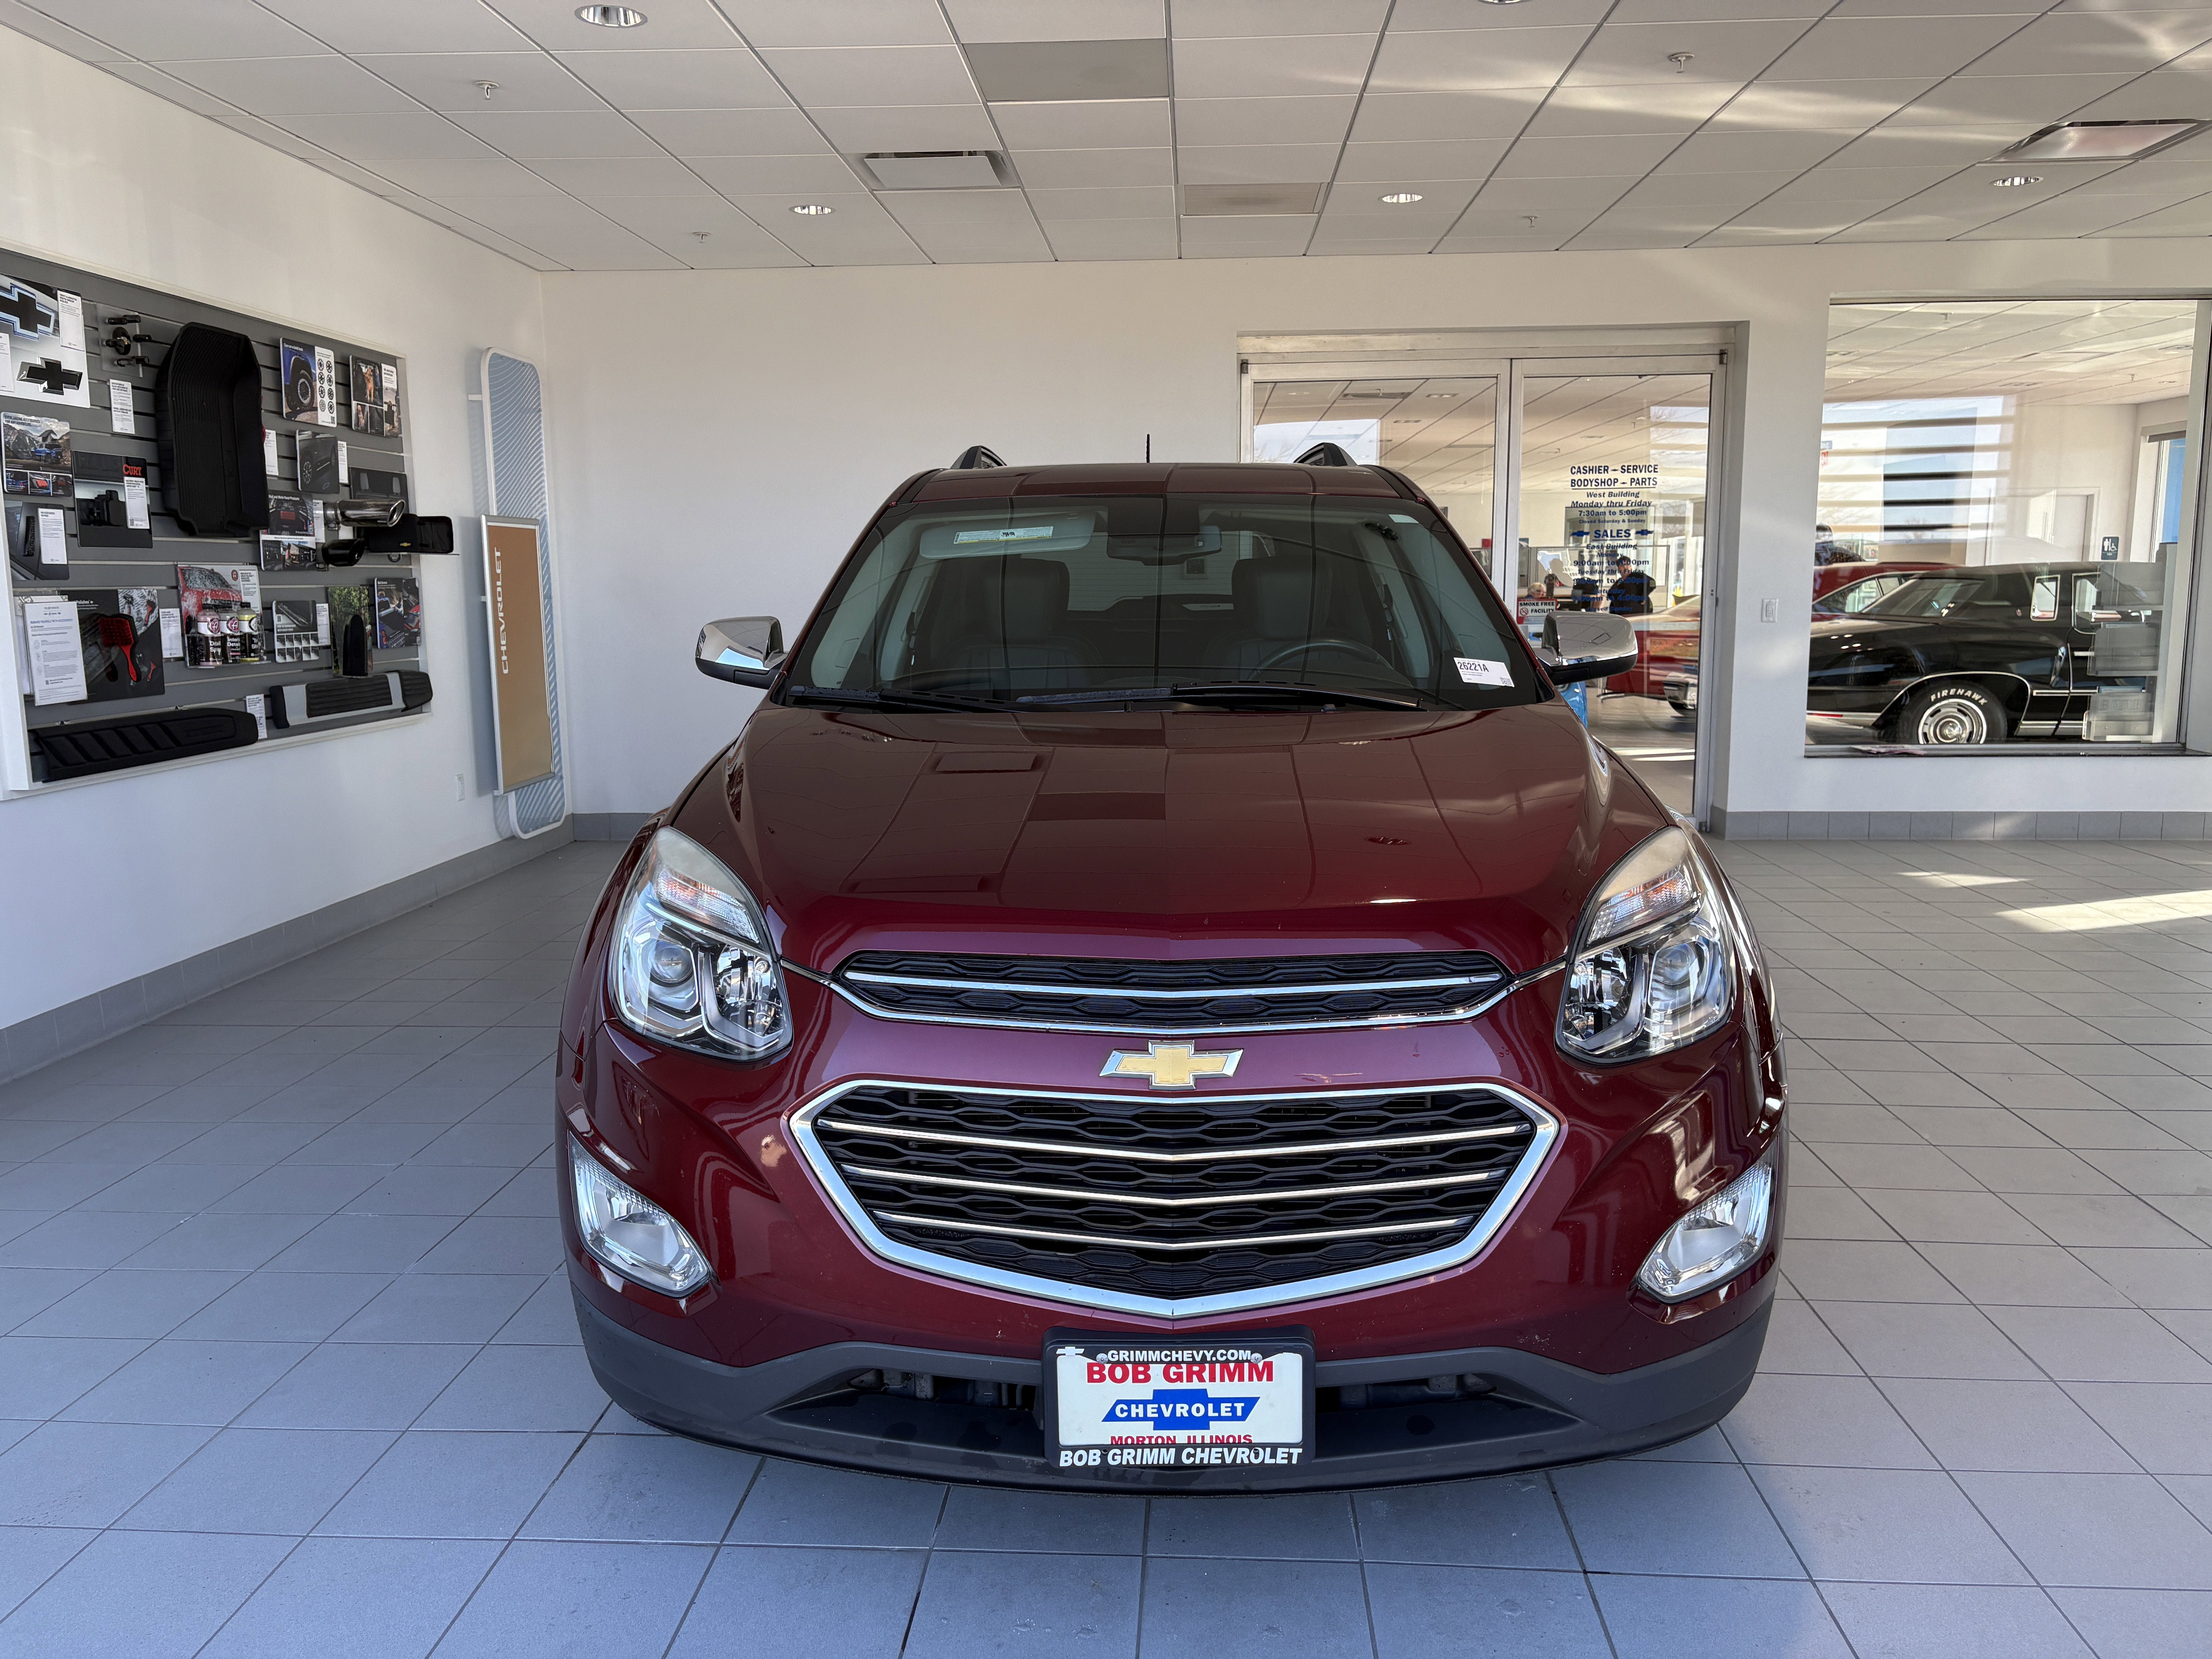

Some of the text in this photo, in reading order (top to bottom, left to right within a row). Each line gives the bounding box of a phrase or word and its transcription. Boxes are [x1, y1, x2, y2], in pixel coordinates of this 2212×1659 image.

[123, 464, 142, 476] CURT
[1570, 465, 1609, 475] CASHIER
[1620, 464, 1659, 474] SERVICE
[1570, 478, 1619, 487] BODYSHOP
[1630, 477, 1657, 486] PARTS
[1594, 529, 1631, 538] SALES
[494, 547, 508, 674] CHEVROLET
[1458, 661, 1489, 672] 26221A
[1930, 688, 1988, 706] FIREHAWK
[1108, 1350, 1251, 1362] GRIMMCHEVY.COM
[1087, 1361, 1273, 1384] BOB GRIMM
[1115, 1403, 1245, 1418] CHEVROLET
[1110, 1435, 1176, 1444] MORTON
[1059, 1447, 1303, 1467] BOB GRIMM CHEVROLET
